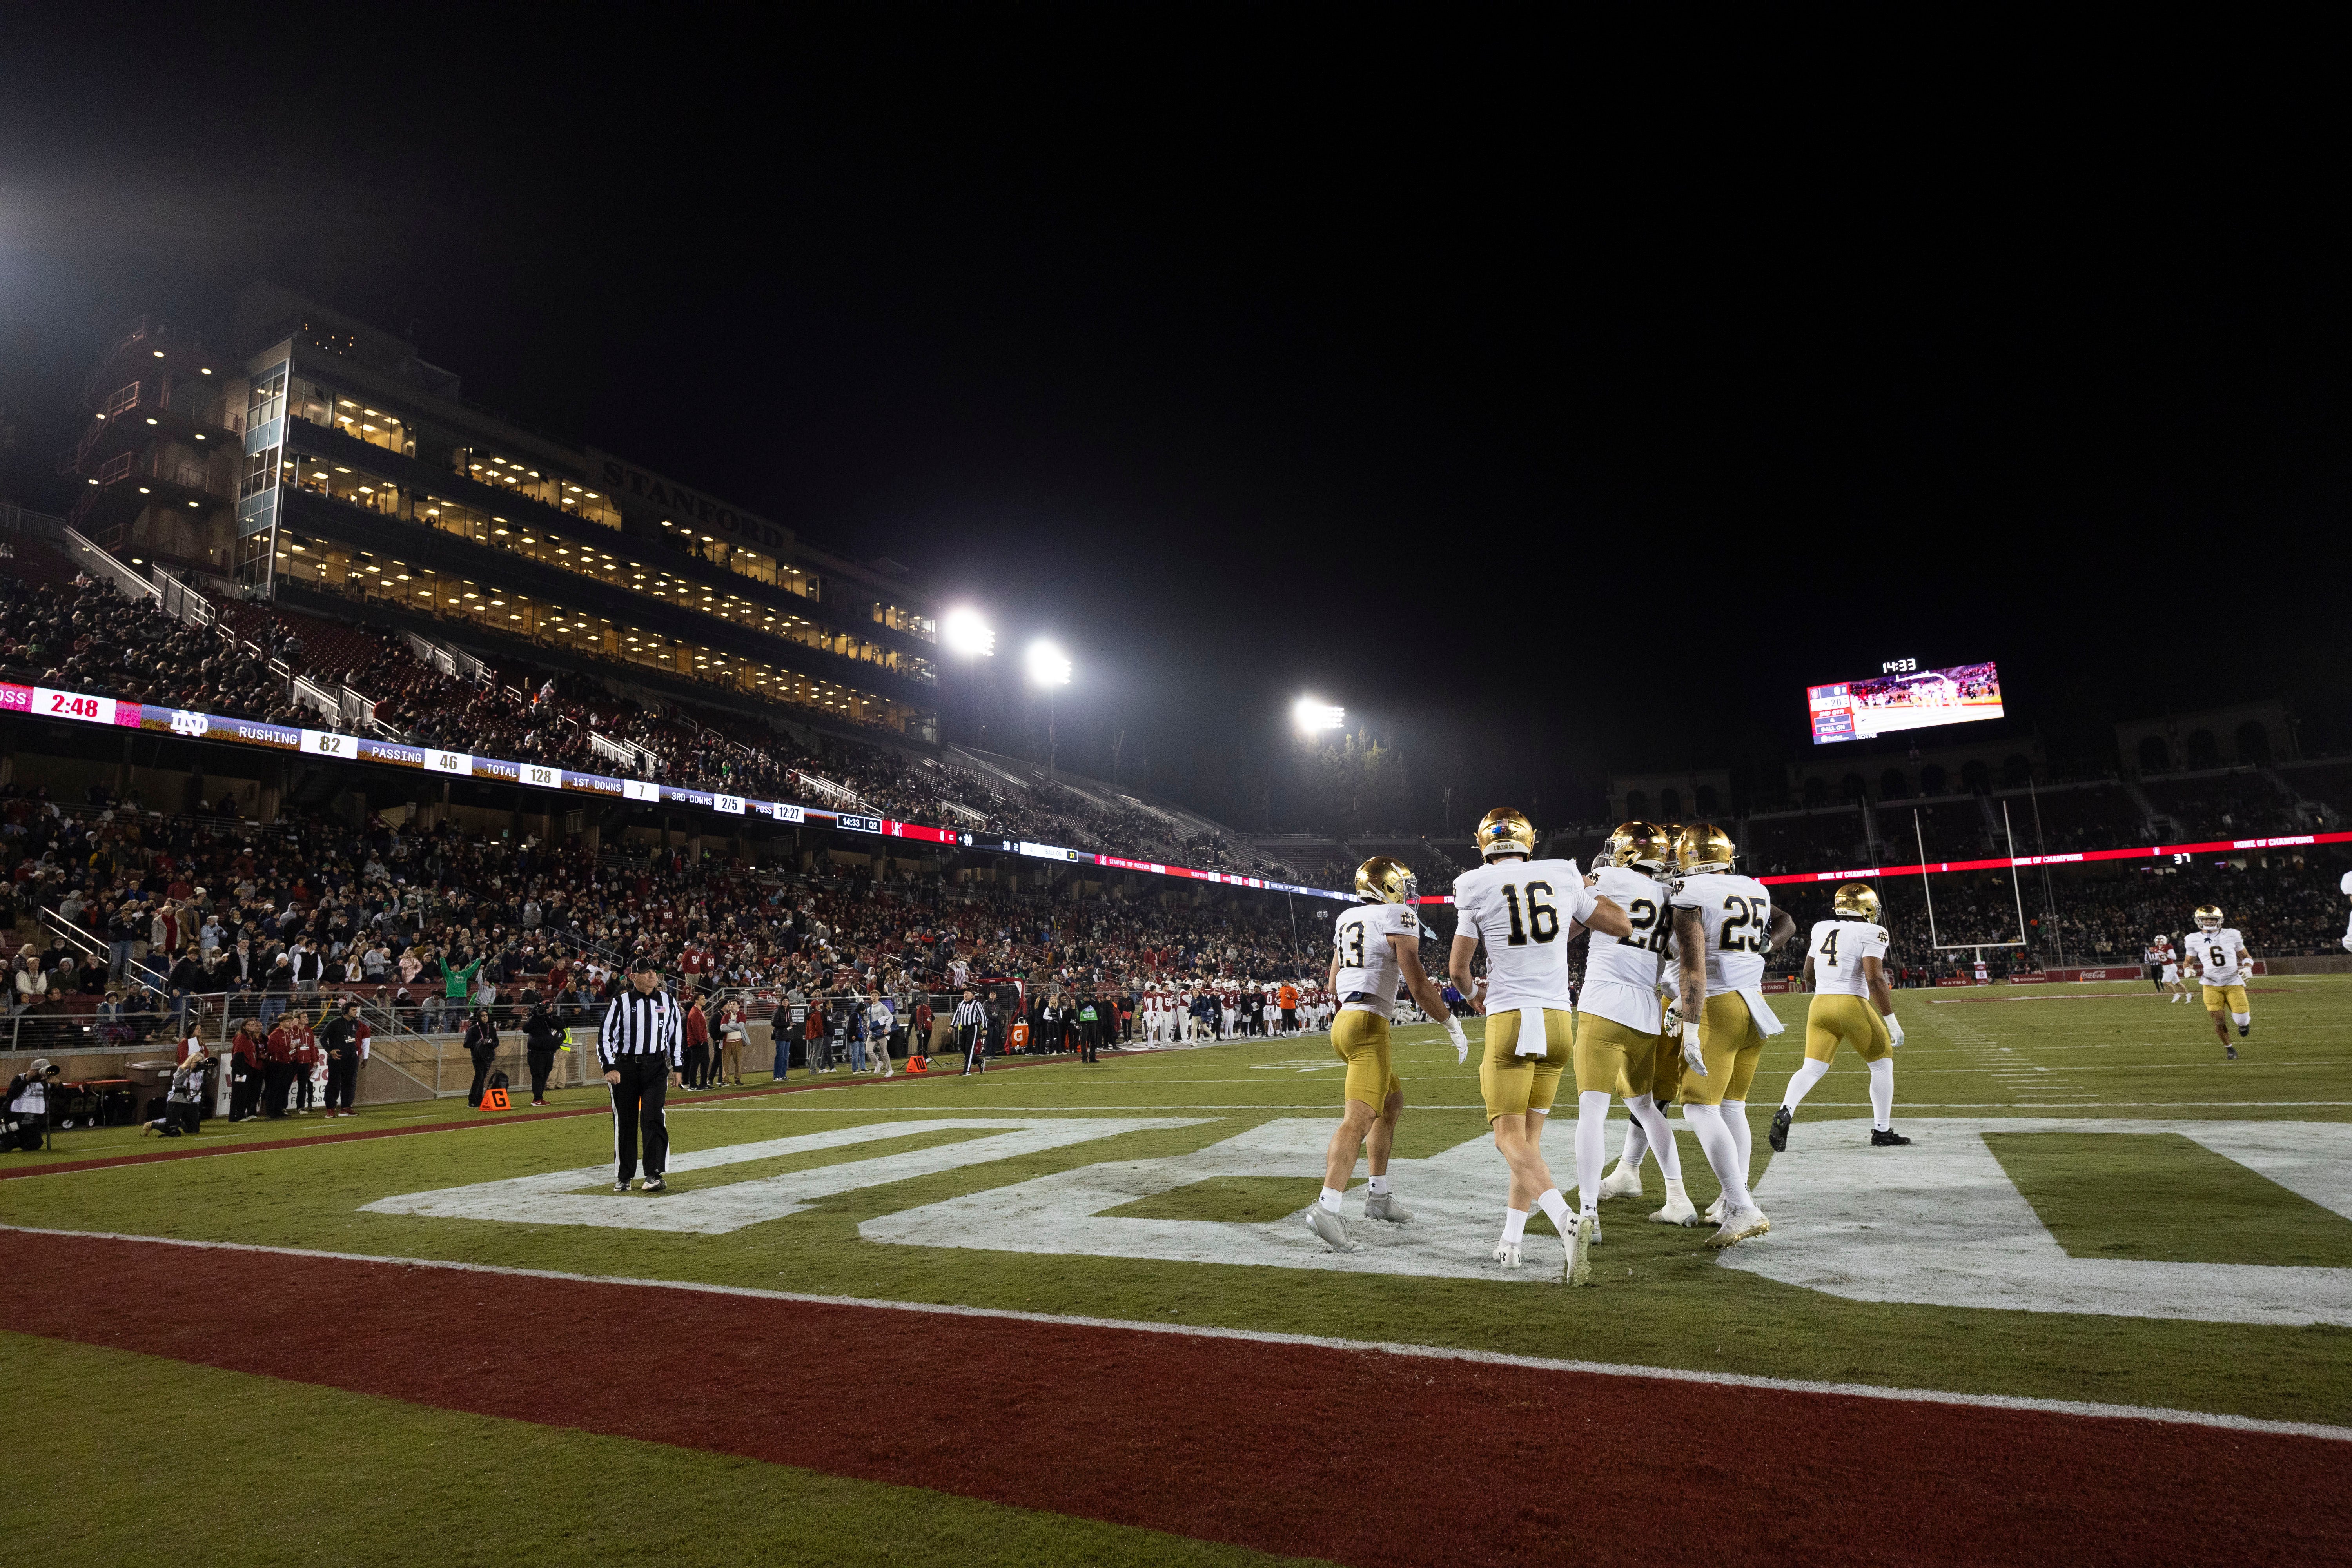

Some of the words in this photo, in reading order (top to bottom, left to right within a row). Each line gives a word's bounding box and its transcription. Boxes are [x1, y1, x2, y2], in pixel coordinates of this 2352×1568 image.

[603, 461, 784, 548] STANFORD
[1883, 658, 1916, 673] 14:33
[51, 695, 98, 717] 2:48
[1831, 699, 1841, 707] 20
[239, 726, 297, 745] RUSHING
[319, 736, 341, 753] 82
[372, 746, 422, 763] PASSING
[439, 755, 457, 770] 46
[486, 764, 517, 777] TOTAL
[530, 769, 551, 783] 128
[573, 777, 590, 788] 1ST
[594, 781, 622, 793] DOWNS
[639, 785, 645, 797] 7
[671, 792, 686, 802] 3RD
[690, 795, 713, 806] DOWNS
[722, 797, 738, 811] 2/5
[756, 805, 772, 815] POSS
[779, 806, 799, 819] 12:27
[843, 817, 860, 828] 14:33
[868, 821, 878, 830] Q2
[940, 831, 945, 842] 0
[2233, 840, 2256, 849] HOME
[2268, 836, 2314, 846] CHAMPIONS
[1003, 840, 1011, 851] 20
[2013, 857, 2032, 866] HOME
[2043, 853, 2083, 863] CHAMPIONS
[2174, 853, 2191, 864] 37
[1844, 869, 1880, 878] CHAMPIONS
[1501, 880, 1560, 946] 16
[1617, 897, 1673, 954] 28
[1719, 894, 1766, 953] 25
[1338, 921, 1366, 969] 13
[1820, 929, 1840, 967] 4
[691, 955, 700, 964] 84
[707, 958, 715, 967] 84
[2210, 945, 2226, 967] 6
[1267, 995, 1272, 1004] 0
[1014, 1029, 1023, 1042] G
[913, 1057, 926, 1071] 10
[491, 1090, 506, 1107] G
